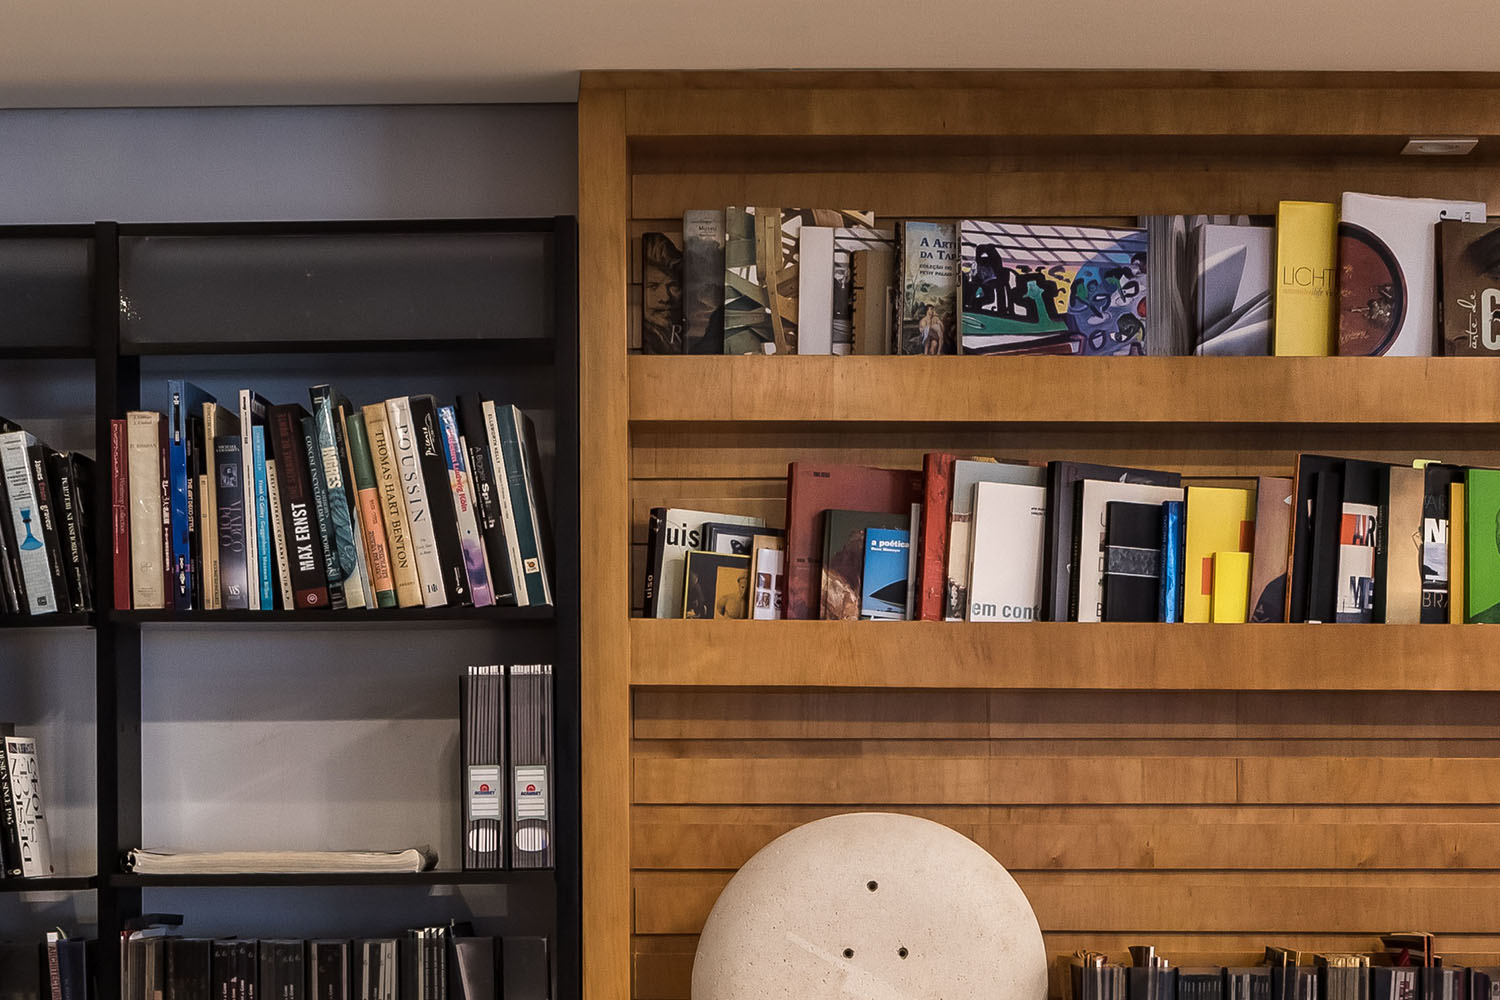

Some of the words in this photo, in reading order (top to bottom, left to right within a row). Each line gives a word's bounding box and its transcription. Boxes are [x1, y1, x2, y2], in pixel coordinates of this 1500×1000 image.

[920, 237, 929, 247] A
[920, 250, 933, 260] DA
[321, 447, 342, 490] INGRES
[395, 424, 426, 523] POUSSIN
[375, 431, 392, 481] THOMAS
[385, 483, 399, 517] HART
[392, 521, 409, 569] BENTON
[291, 503, 311, 540] ERNST
[300, 541, 316, 572] MAX
[972, 602, 997, 618] em
